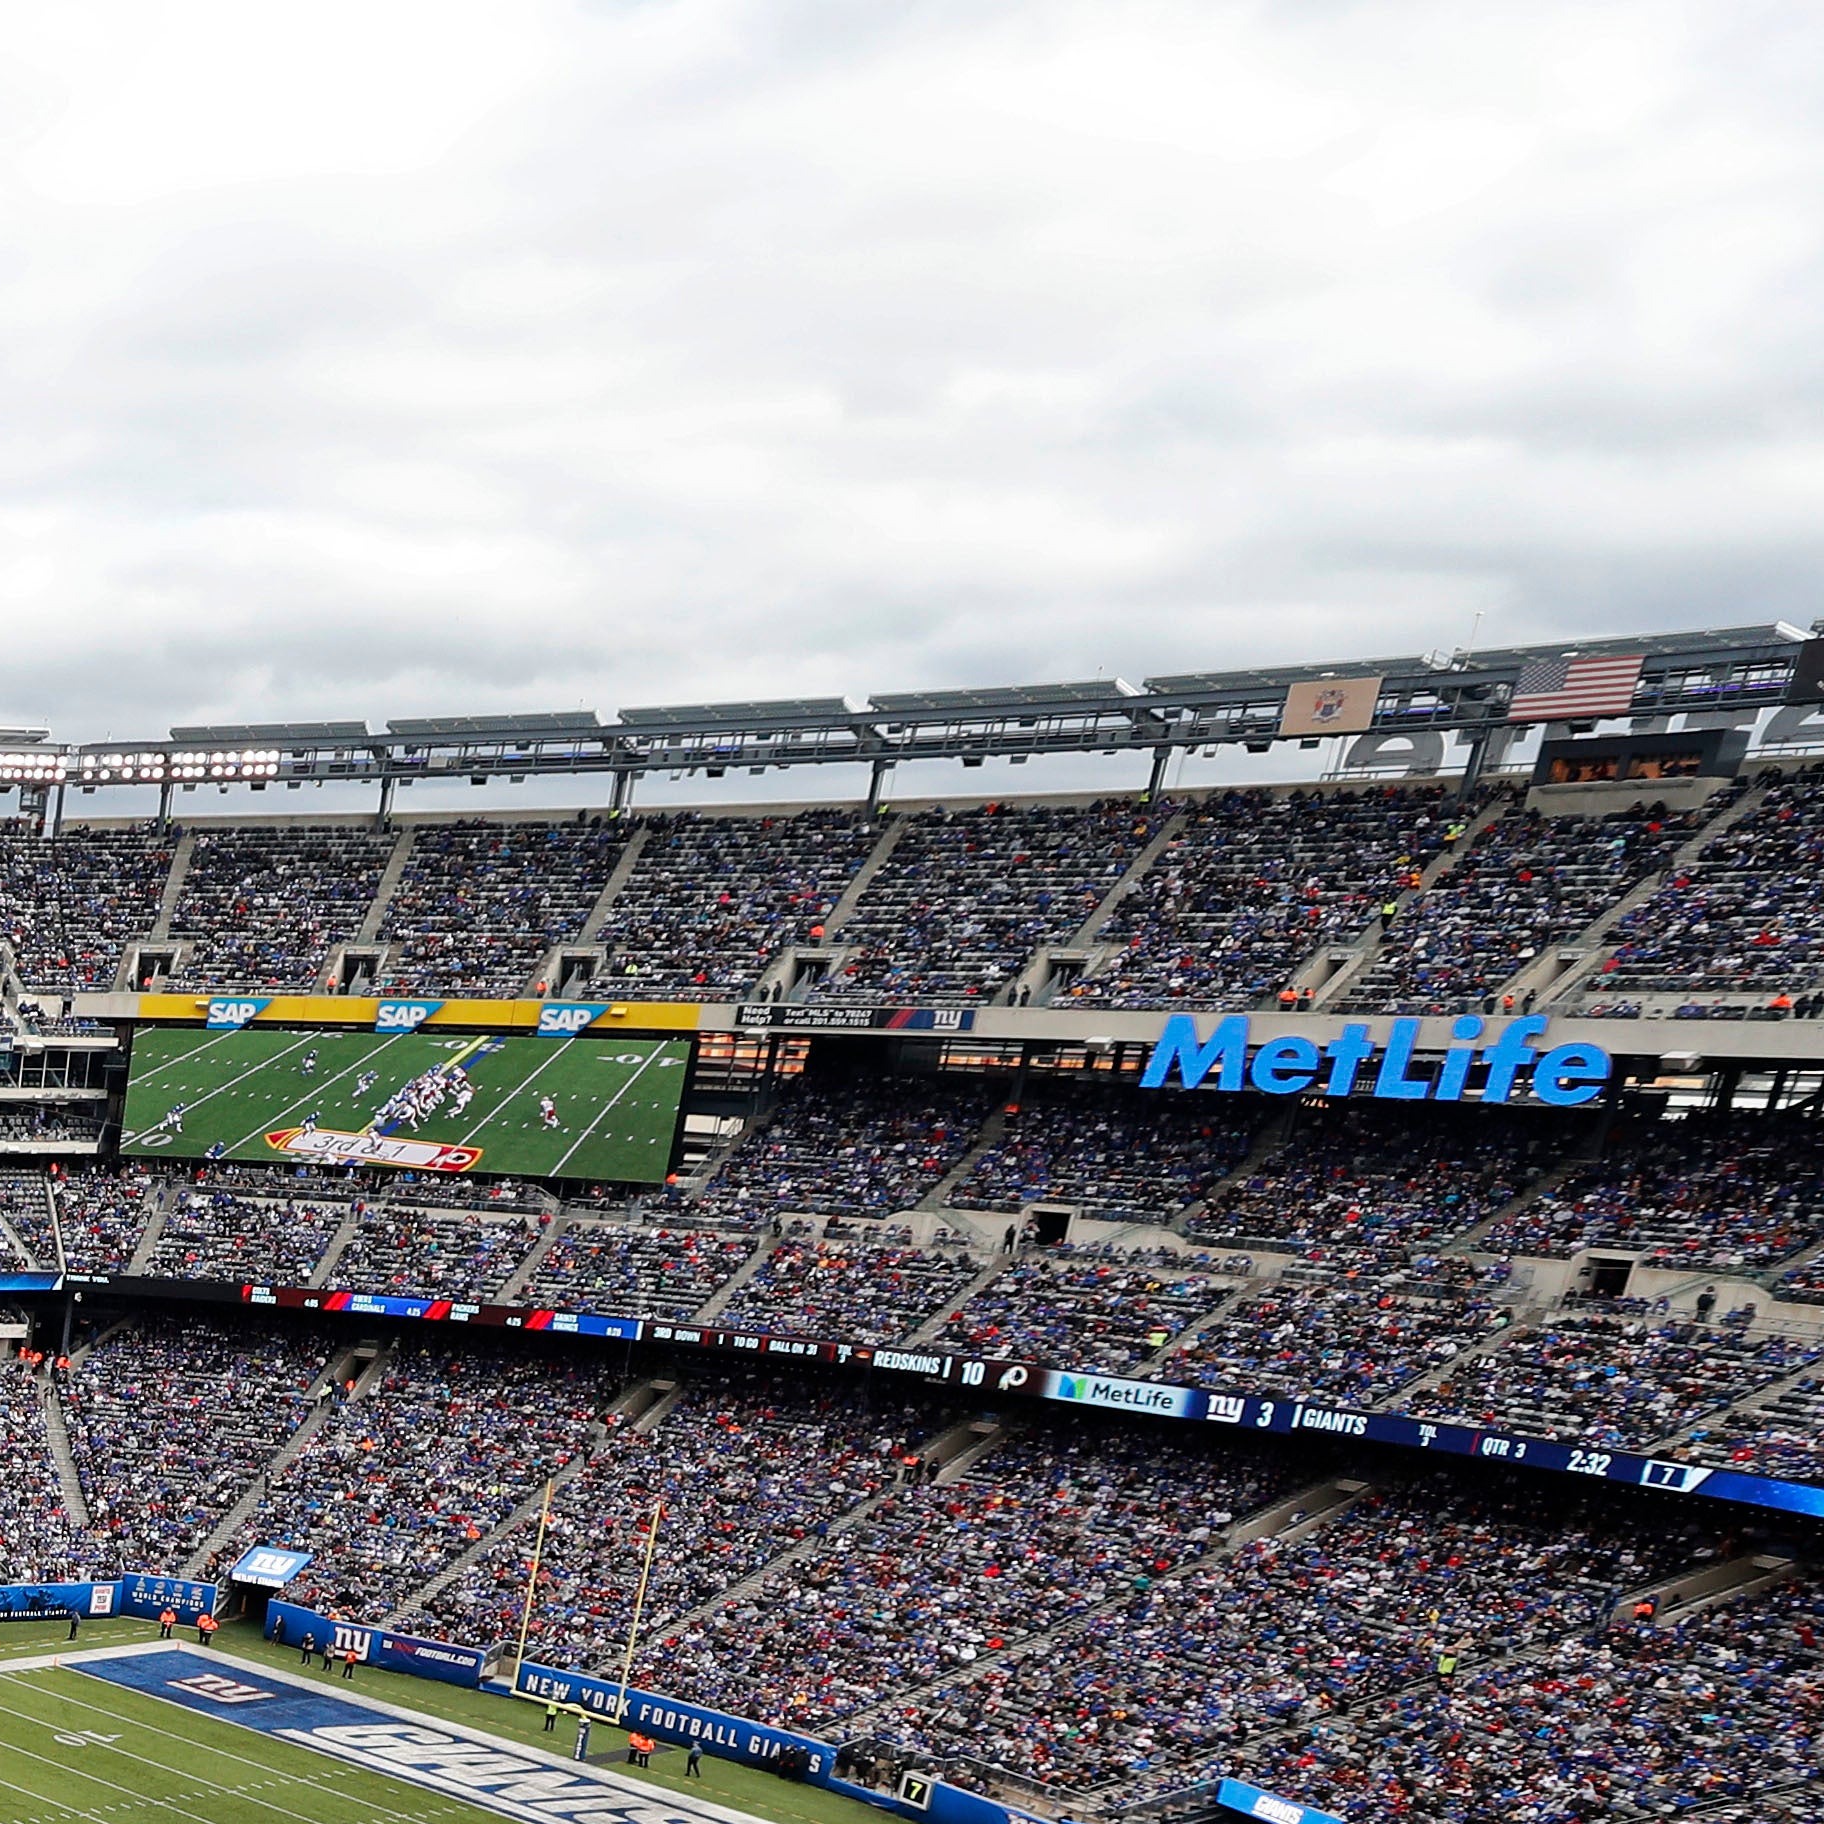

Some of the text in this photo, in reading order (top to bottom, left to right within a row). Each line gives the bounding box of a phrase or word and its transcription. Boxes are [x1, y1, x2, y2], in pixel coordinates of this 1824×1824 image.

[207, 1003, 255, 1024] SAP
[378, 1005, 427, 1027] SAP
[540, 1008, 592, 1032] SAP
[742, 1015, 772, 1026] Help?
[743, 1006, 771, 1015] Need
[1139, 1014, 1611, 1105] MetLife
[314, 1136, 408, 1158] 3rd 1
[675, 1329, 700, 1343] DOWN
[873, 1350, 986, 1385] REDSKINS 10
[1091, 1383, 1173, 1410] MetLife
[1256, 1401, 1274, 1428] 3
[1302, 1410, 1367, 1435] GIANTS
[1481, 1436, 1527, 1458] QTR 3
[1566, 1450, 1612, 1477] 2:32
[1661, 1467, 1673, 1485] 7
[526, 1674, 739, 1748] NEW YORK FOOTBALL
[53, 1731, 113, 1747] 10
[910, 1781, 924, 1799] 7
